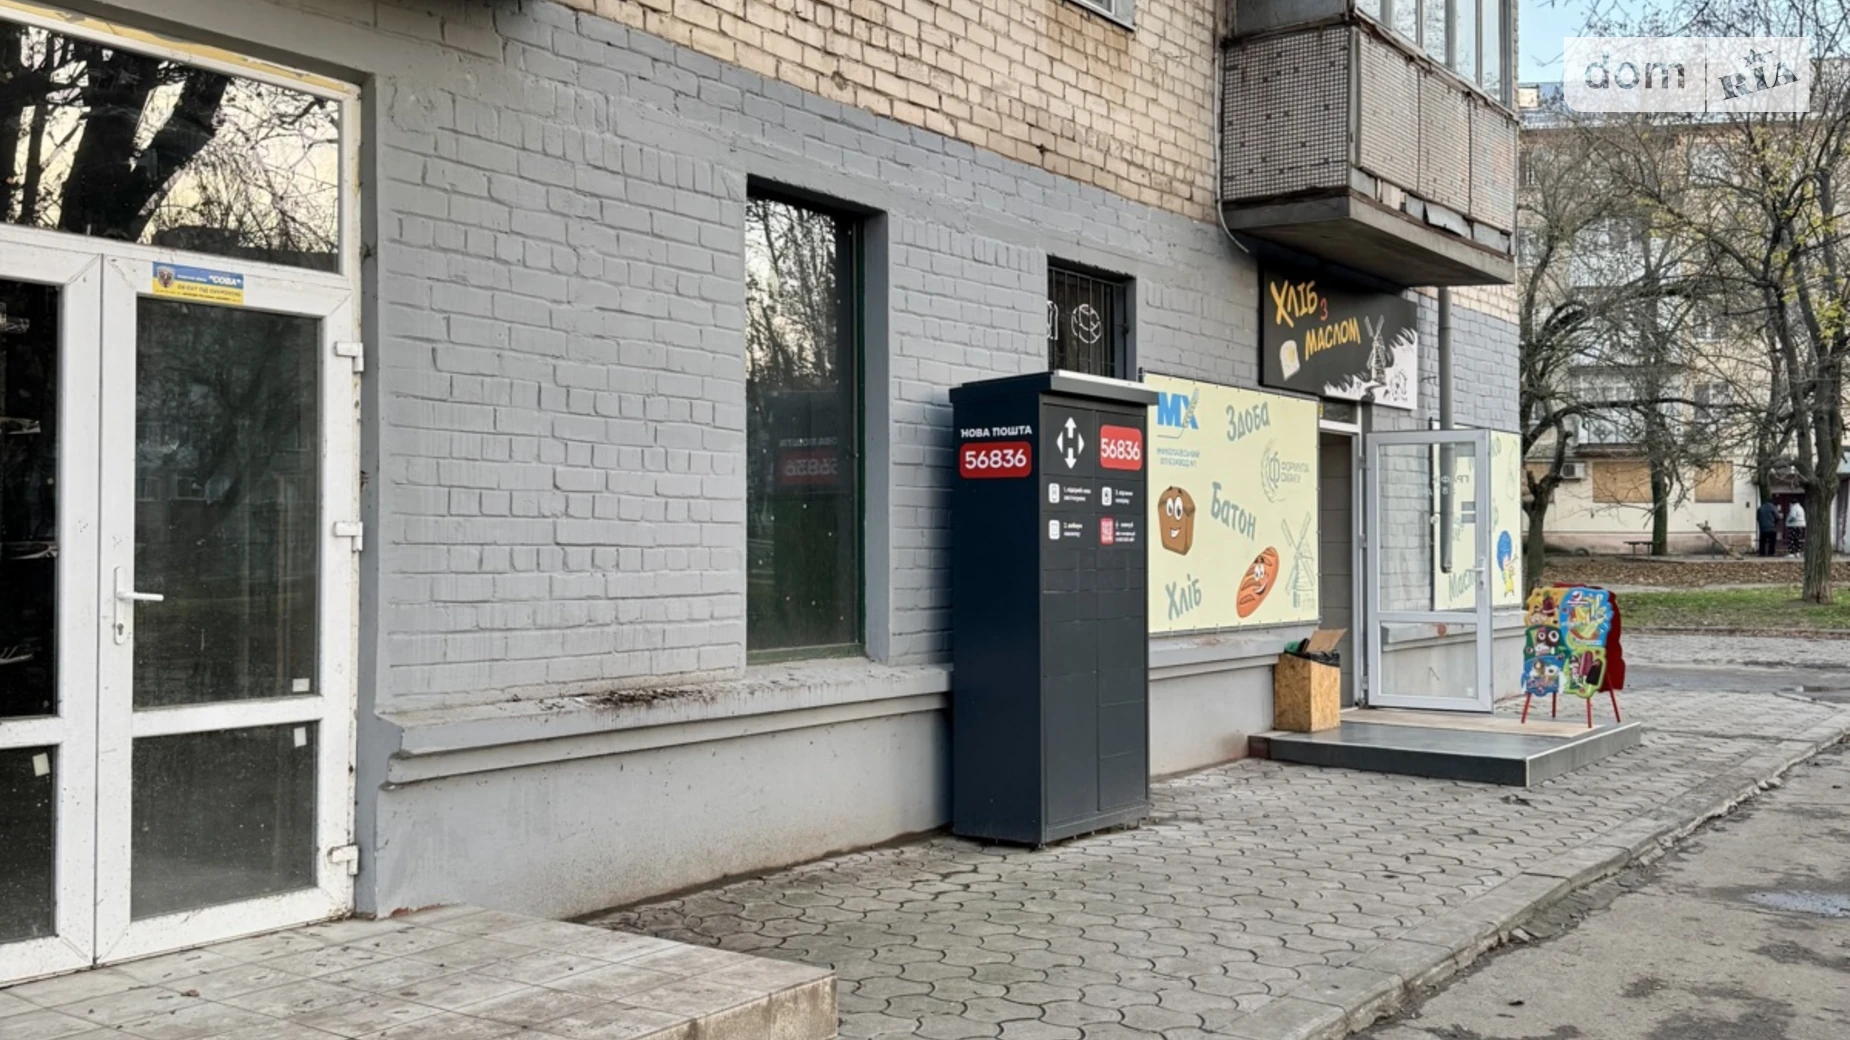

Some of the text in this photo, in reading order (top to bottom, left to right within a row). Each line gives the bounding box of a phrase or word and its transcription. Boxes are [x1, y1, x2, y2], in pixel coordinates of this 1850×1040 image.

[1270, 280, 1318, 328] ХЛІБ
[1304, 316, 1362, 362] МАСЛОМ
[960, 425, 1033, 438] НОВА ПОШТА
[1225, 401, 1270, 442] Здоба
[964, 448, 1027, 470] 56836
[1100, 438, 1141, 461] 56836
[1211, 481, 1257, 541] Батон
[1165, 574, 1202, 621] Хліб
